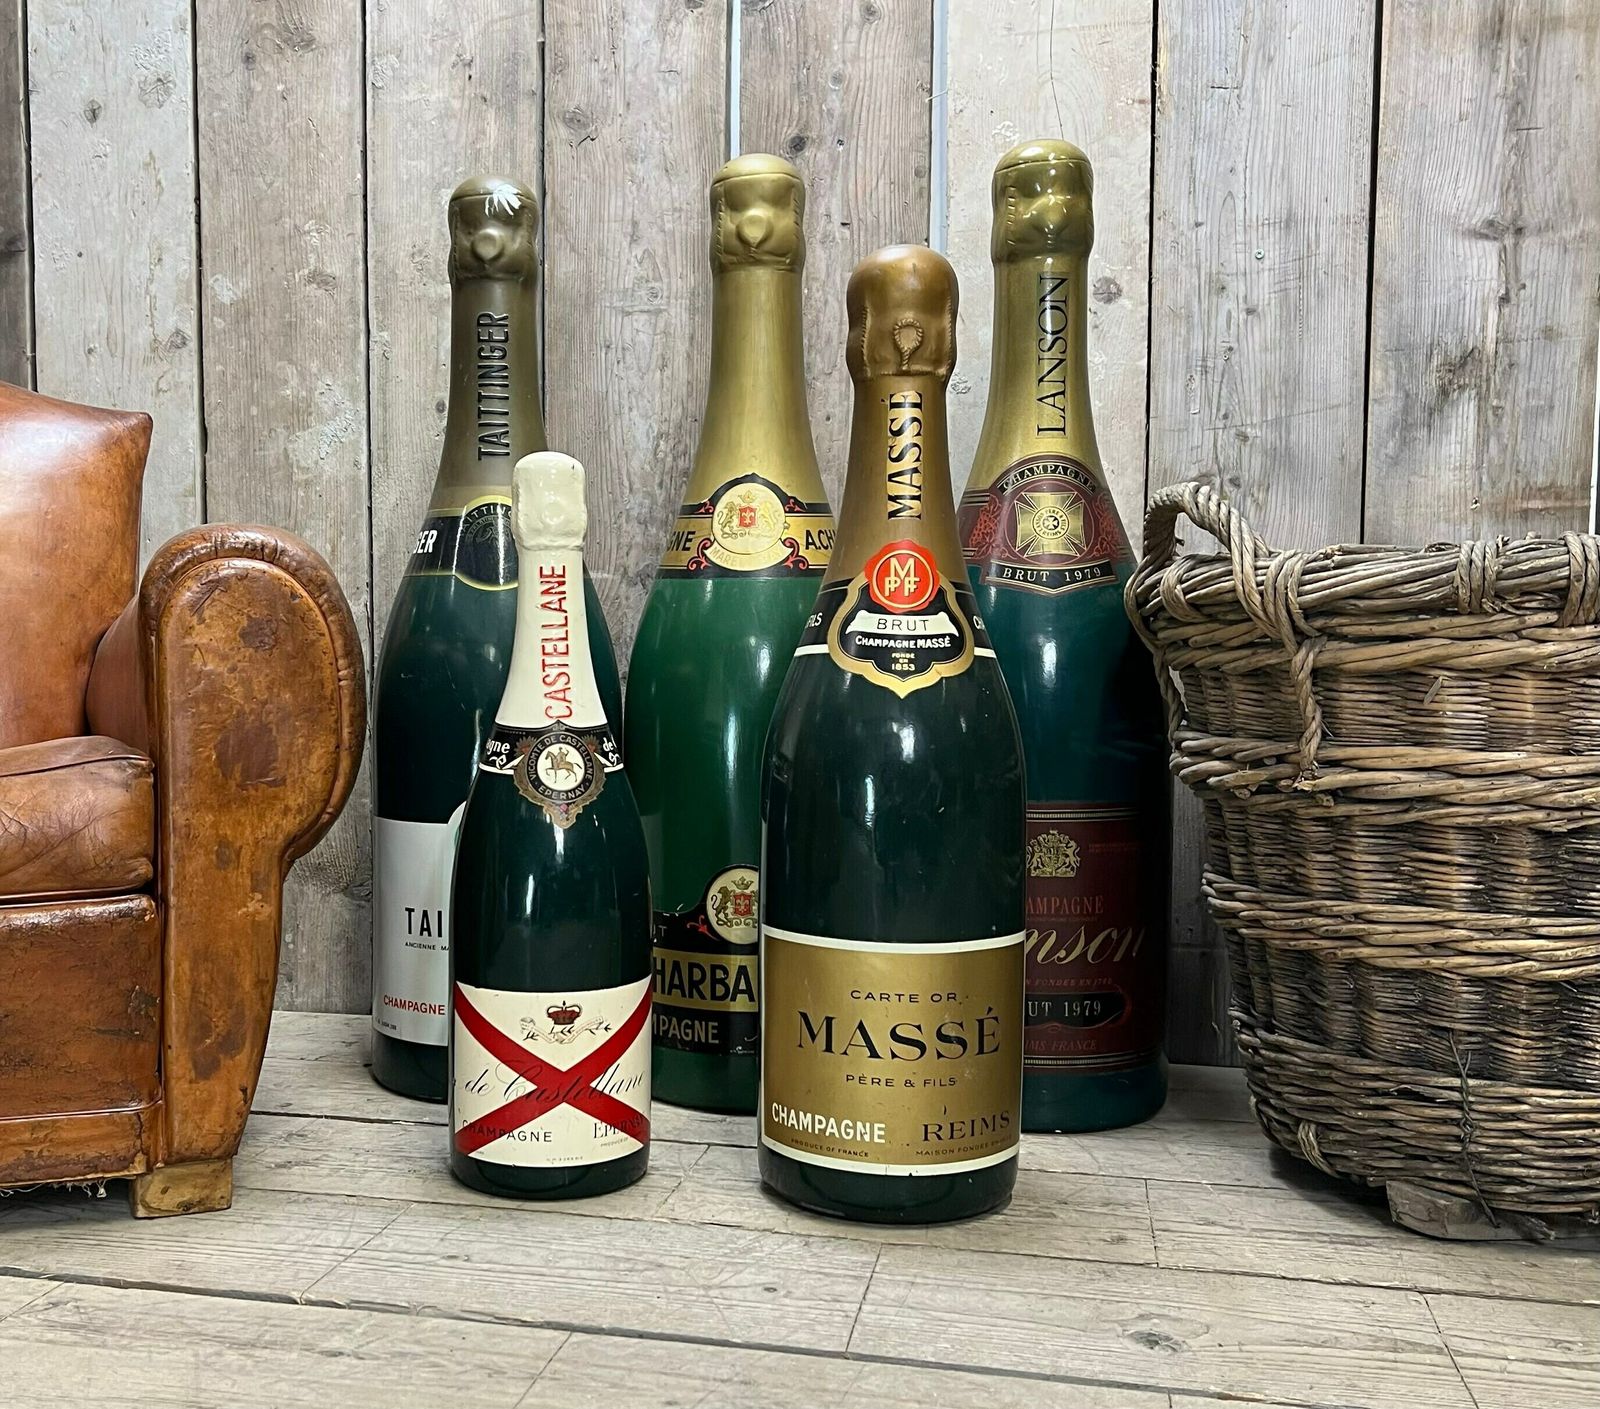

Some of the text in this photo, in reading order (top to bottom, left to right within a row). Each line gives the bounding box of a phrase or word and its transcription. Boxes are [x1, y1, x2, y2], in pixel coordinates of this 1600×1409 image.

[1037, 274, 1069, 436] LANSON
[477, 311, 510, 461] TAITTINGER
[1003, 462, 1096, 493] CHAMPAGNE
[805, 529, 836, 550] A.CH
[1003, 566, 1101, 583] BRUT 1979
[876, 618, 930, 632] BRUT
[539, 565, 573, 719] CASTELLANE
[855, 635, 916, 649] CHAMPAGNE
[528, 734, 593, 780] VICOMTE DE CASTELLANE
[538, 785, 585, 800] EPERNAY
[404, 906, 443, 939] TAI
[404, 941, 436, 951] ANCIENNE
[383, 994, 446, 1016] CHAMPAGNE
[850, 989, 958, 1003] CARTE OR
[1063, 1000, 1101, 1017] 1979
[796, 1006, 1001, 1061] MASSÉ
[464, 1068, 496, 1096] de
[904, 1078, 915, 1088] &
[923, 1077, 957, 1088] FILS
[462, 1119, 553, 1143] CHAMPAGNE
[772, 1102, 886, 1144] CHAMPAGNE
[922, 1110, 1010, 1142] REIMS
[791, 1138, 824, 1151] PRODUCE
[837, 1148, 869, 1158] FRANCE
[915, 1147, 955, 1157] MAISON
